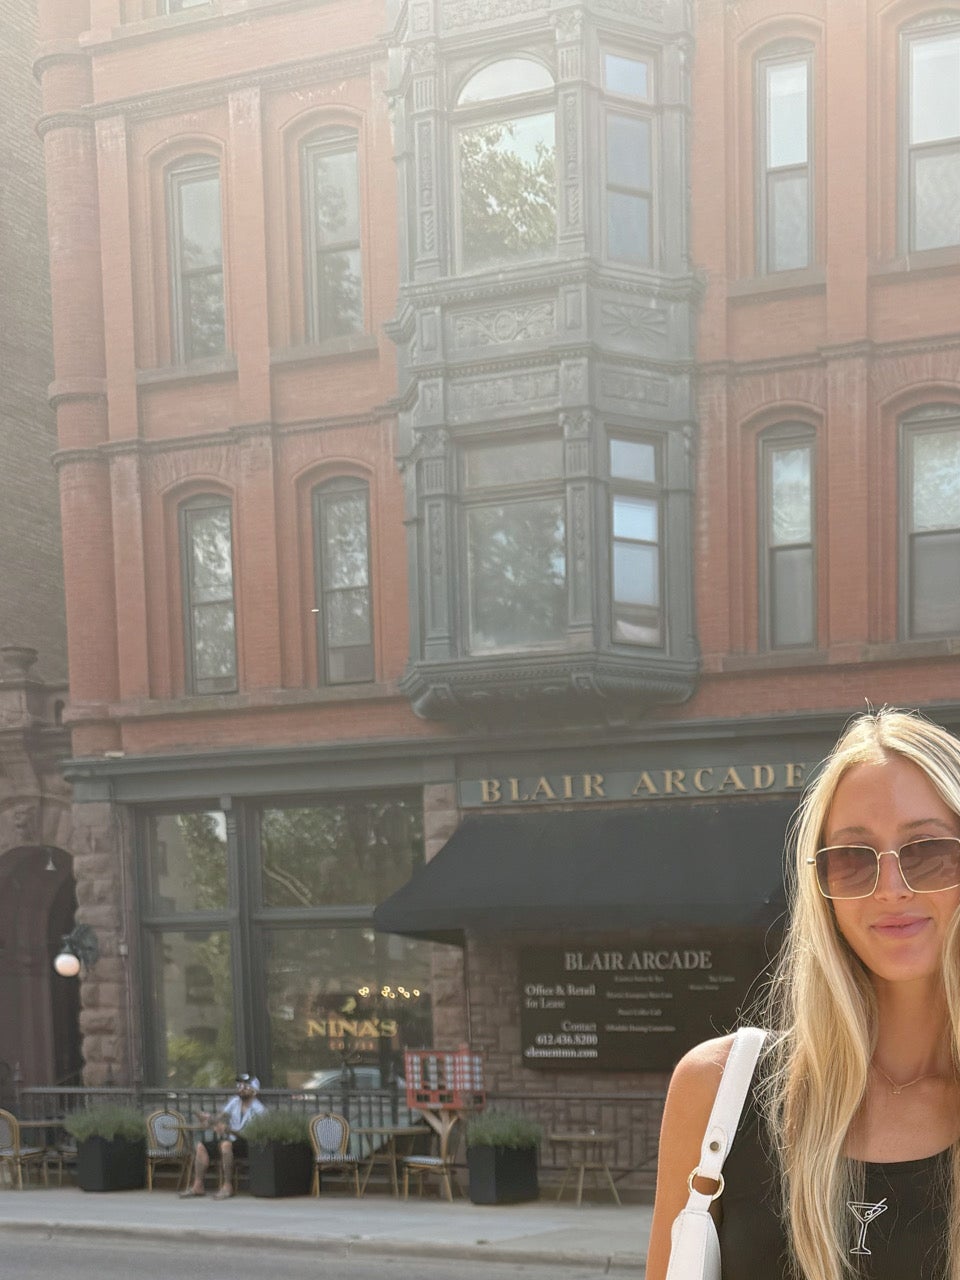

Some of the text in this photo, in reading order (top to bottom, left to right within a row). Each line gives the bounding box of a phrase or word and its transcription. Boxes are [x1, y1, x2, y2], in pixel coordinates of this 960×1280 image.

[480, 763, 807, 803] BLAIR ARCADE
[565, 950, 713, 970] BLAIR ARCADE
[525, 984, 555, 996] Office
[555, 985, 566, 996] &
[567, 983, 596, 996] Retail
[526, 998, 566, 1009] for Lease
[307, 1017, 399, 1038] NINA'S
[561, 1020, 598, 1032] Contact
